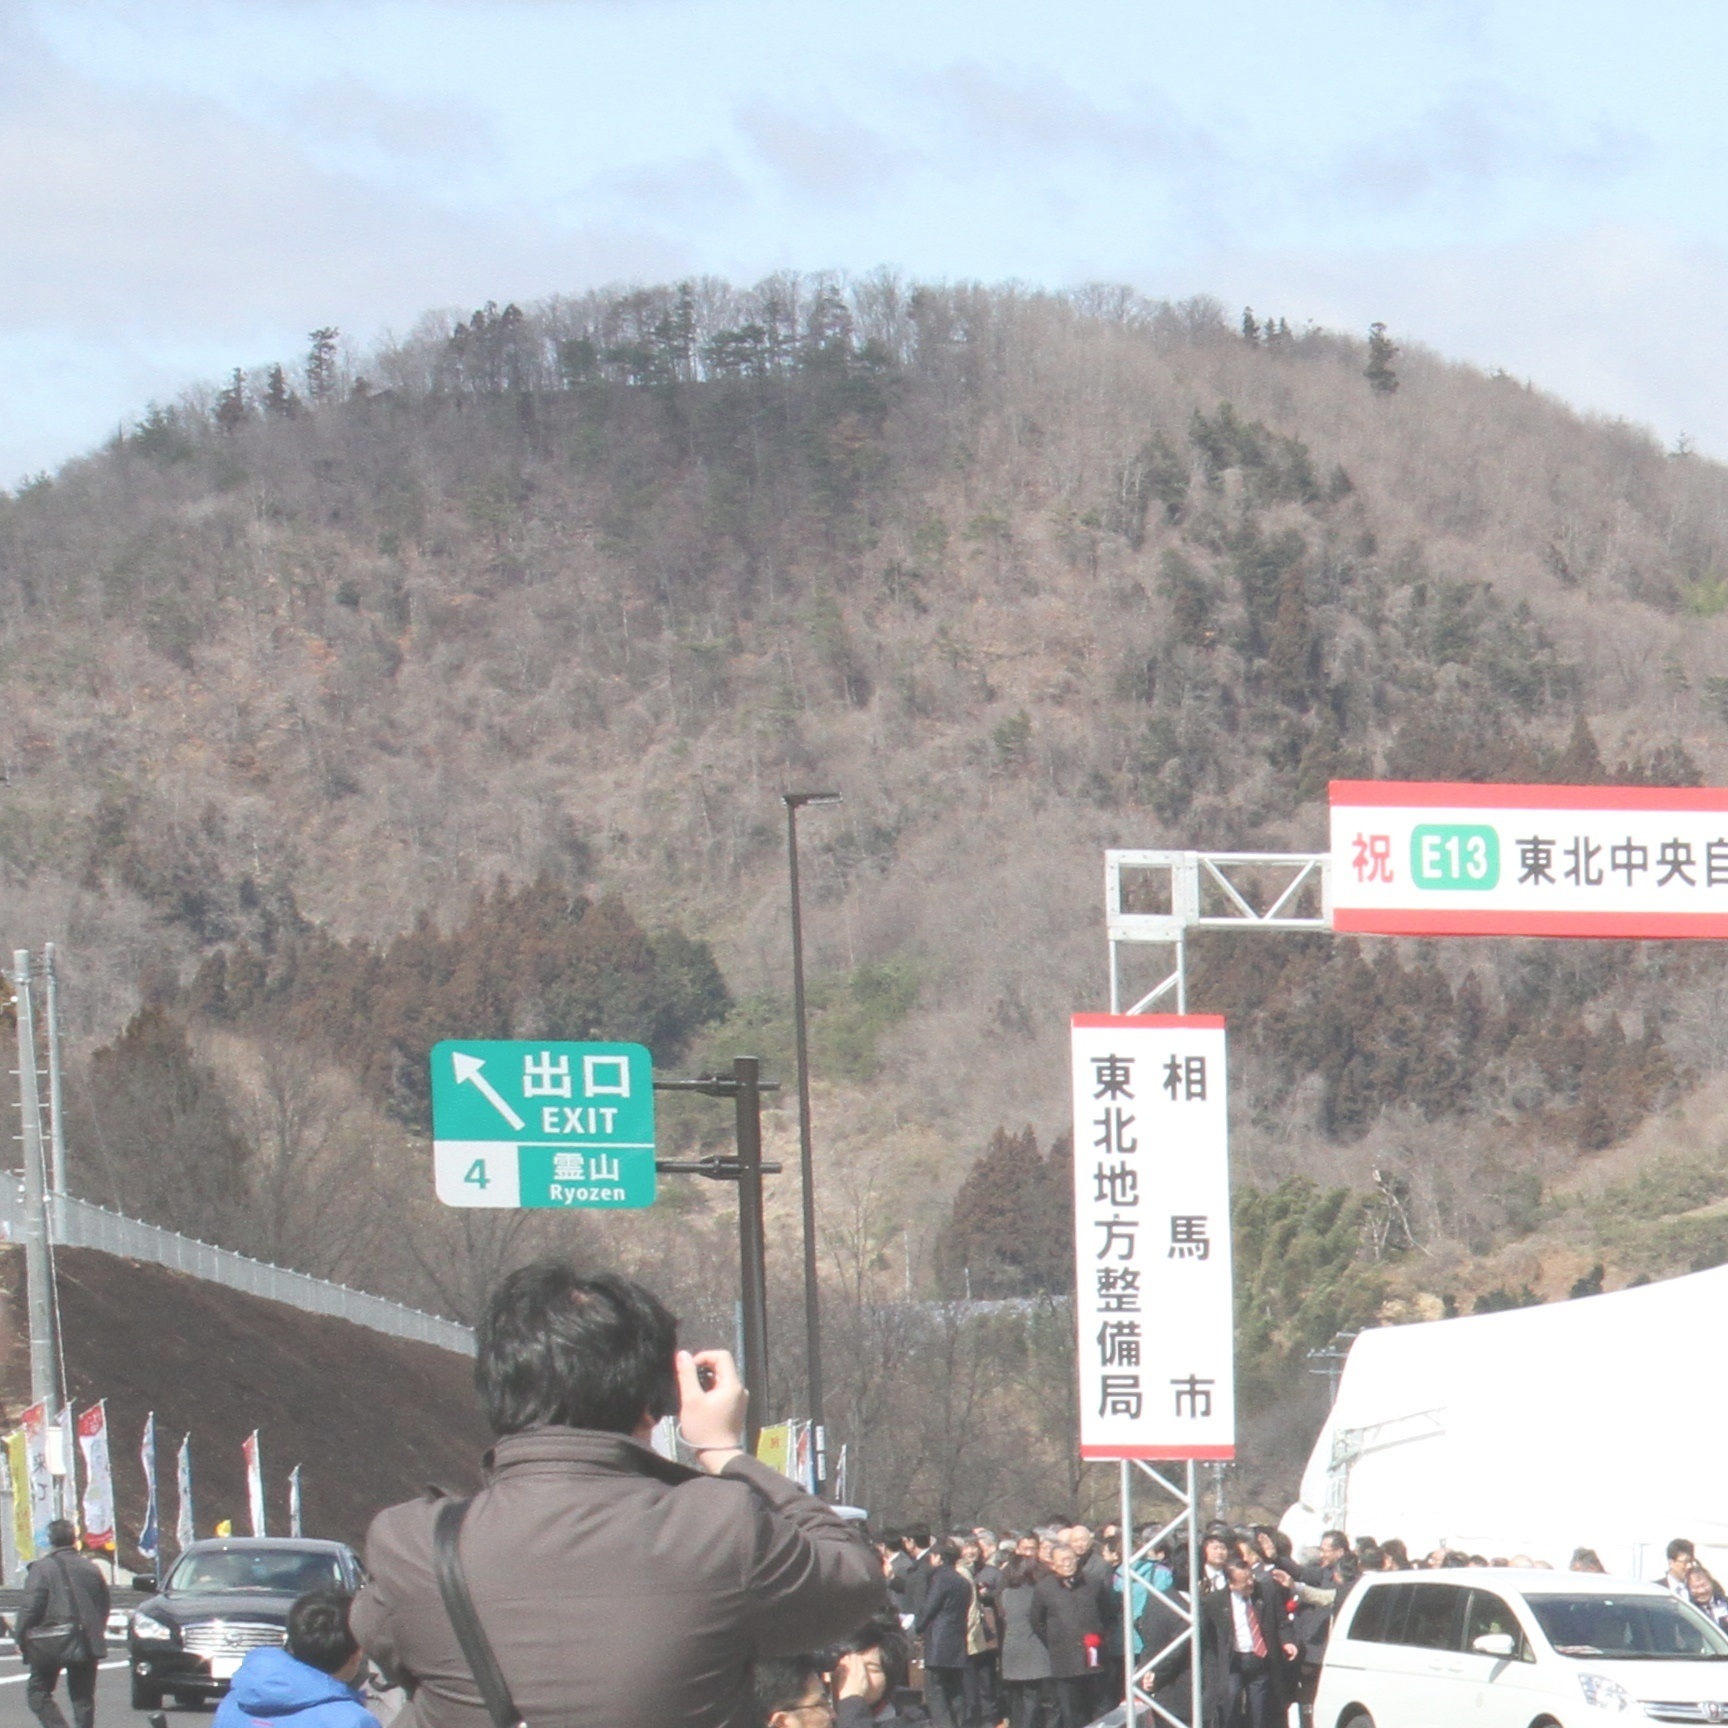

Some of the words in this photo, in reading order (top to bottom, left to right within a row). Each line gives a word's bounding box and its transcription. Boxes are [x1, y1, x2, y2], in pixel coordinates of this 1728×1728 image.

[1351, 832, 1394, 883] 祝
[1421, 834, 1488, 880] E13
[523, 1051, 630, 1098] 出口
[542, 1107, 618, 1134] EXIT
[463, 1158, 490, 1189] 4
[553, 1152, 619, 1181] 霊山
[550, 1184, 625, 1204] Ryozen
[1090, 1053, 1143, 1421] 東北地方整備局
[1163, 1054, 1216, 1420] 相馬市
